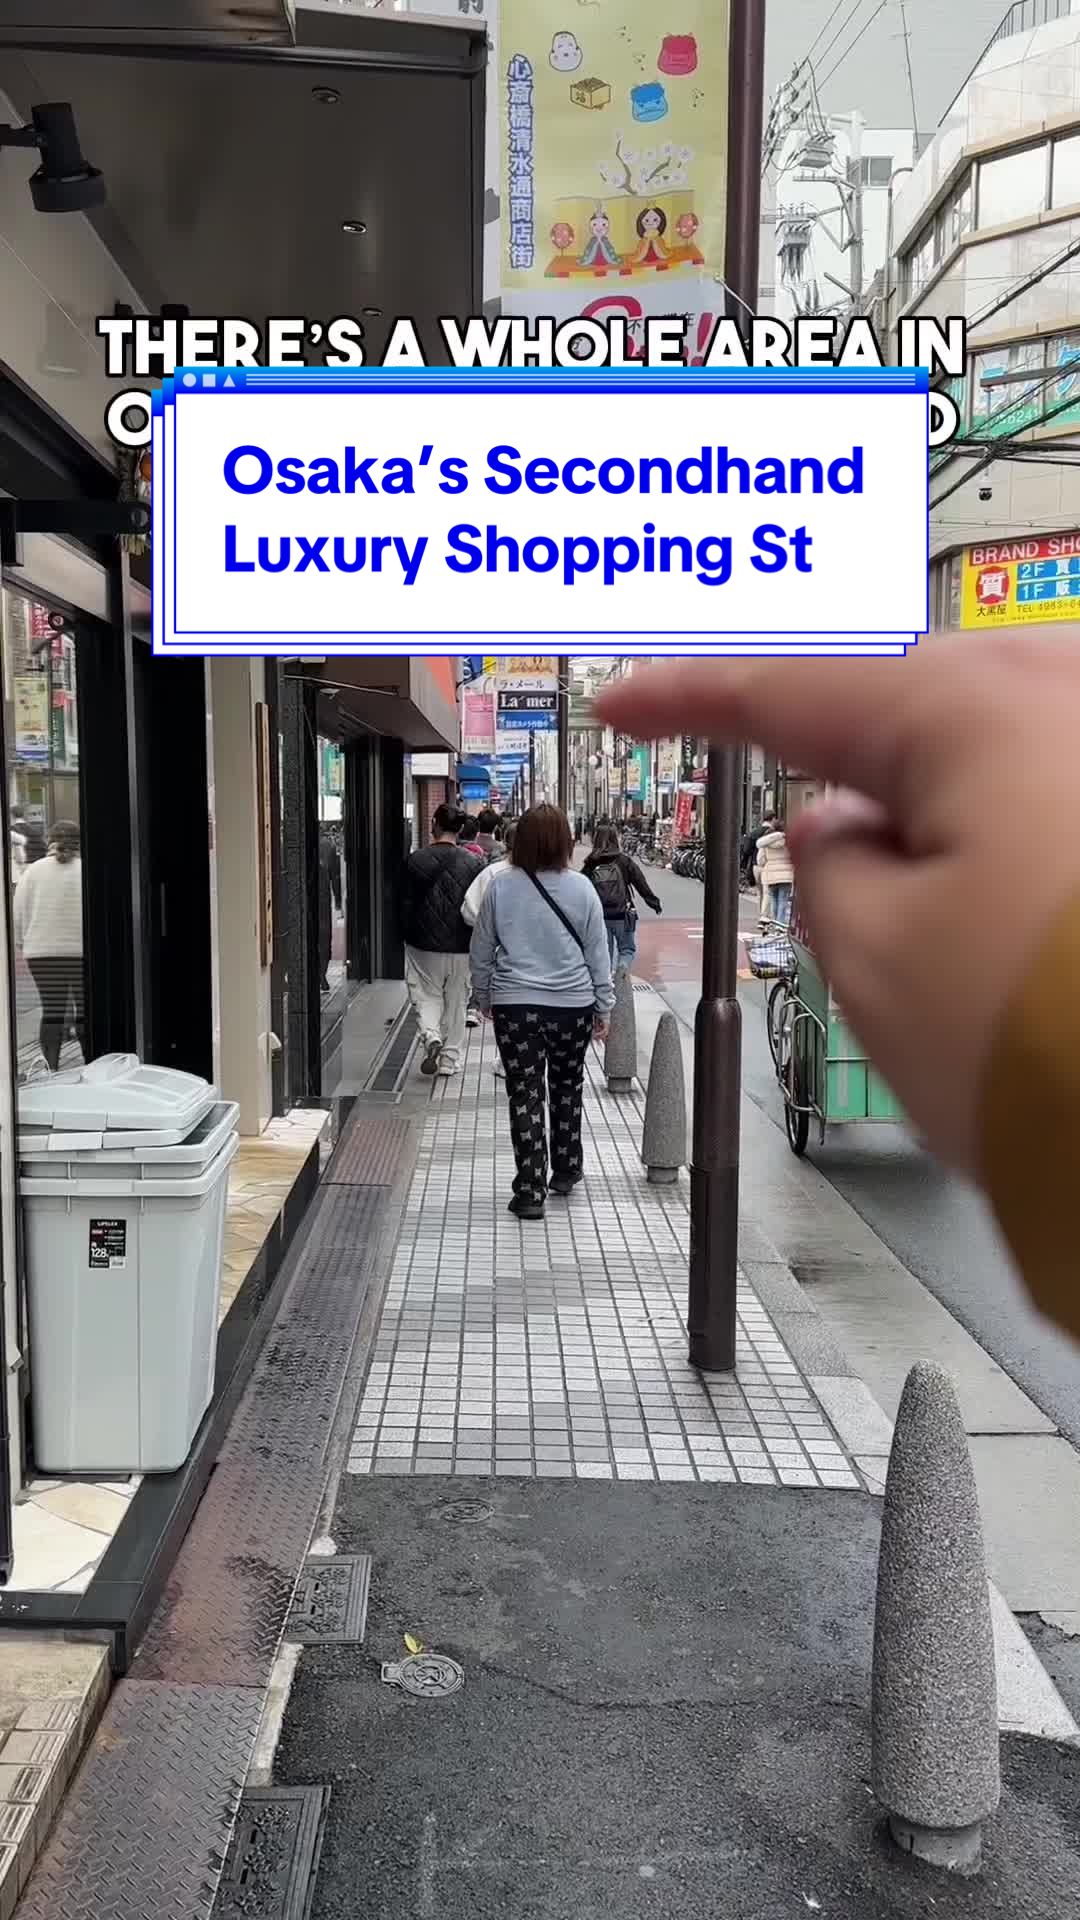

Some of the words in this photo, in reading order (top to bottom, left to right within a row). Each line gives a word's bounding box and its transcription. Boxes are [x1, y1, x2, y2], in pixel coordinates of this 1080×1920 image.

[972, 541, 1040, 565] BRAND
[1021, 562, 1046, 578] 2F
[1022, 583, 1045, 600] 1F
[1017, 604, 1033, 613] TEL
